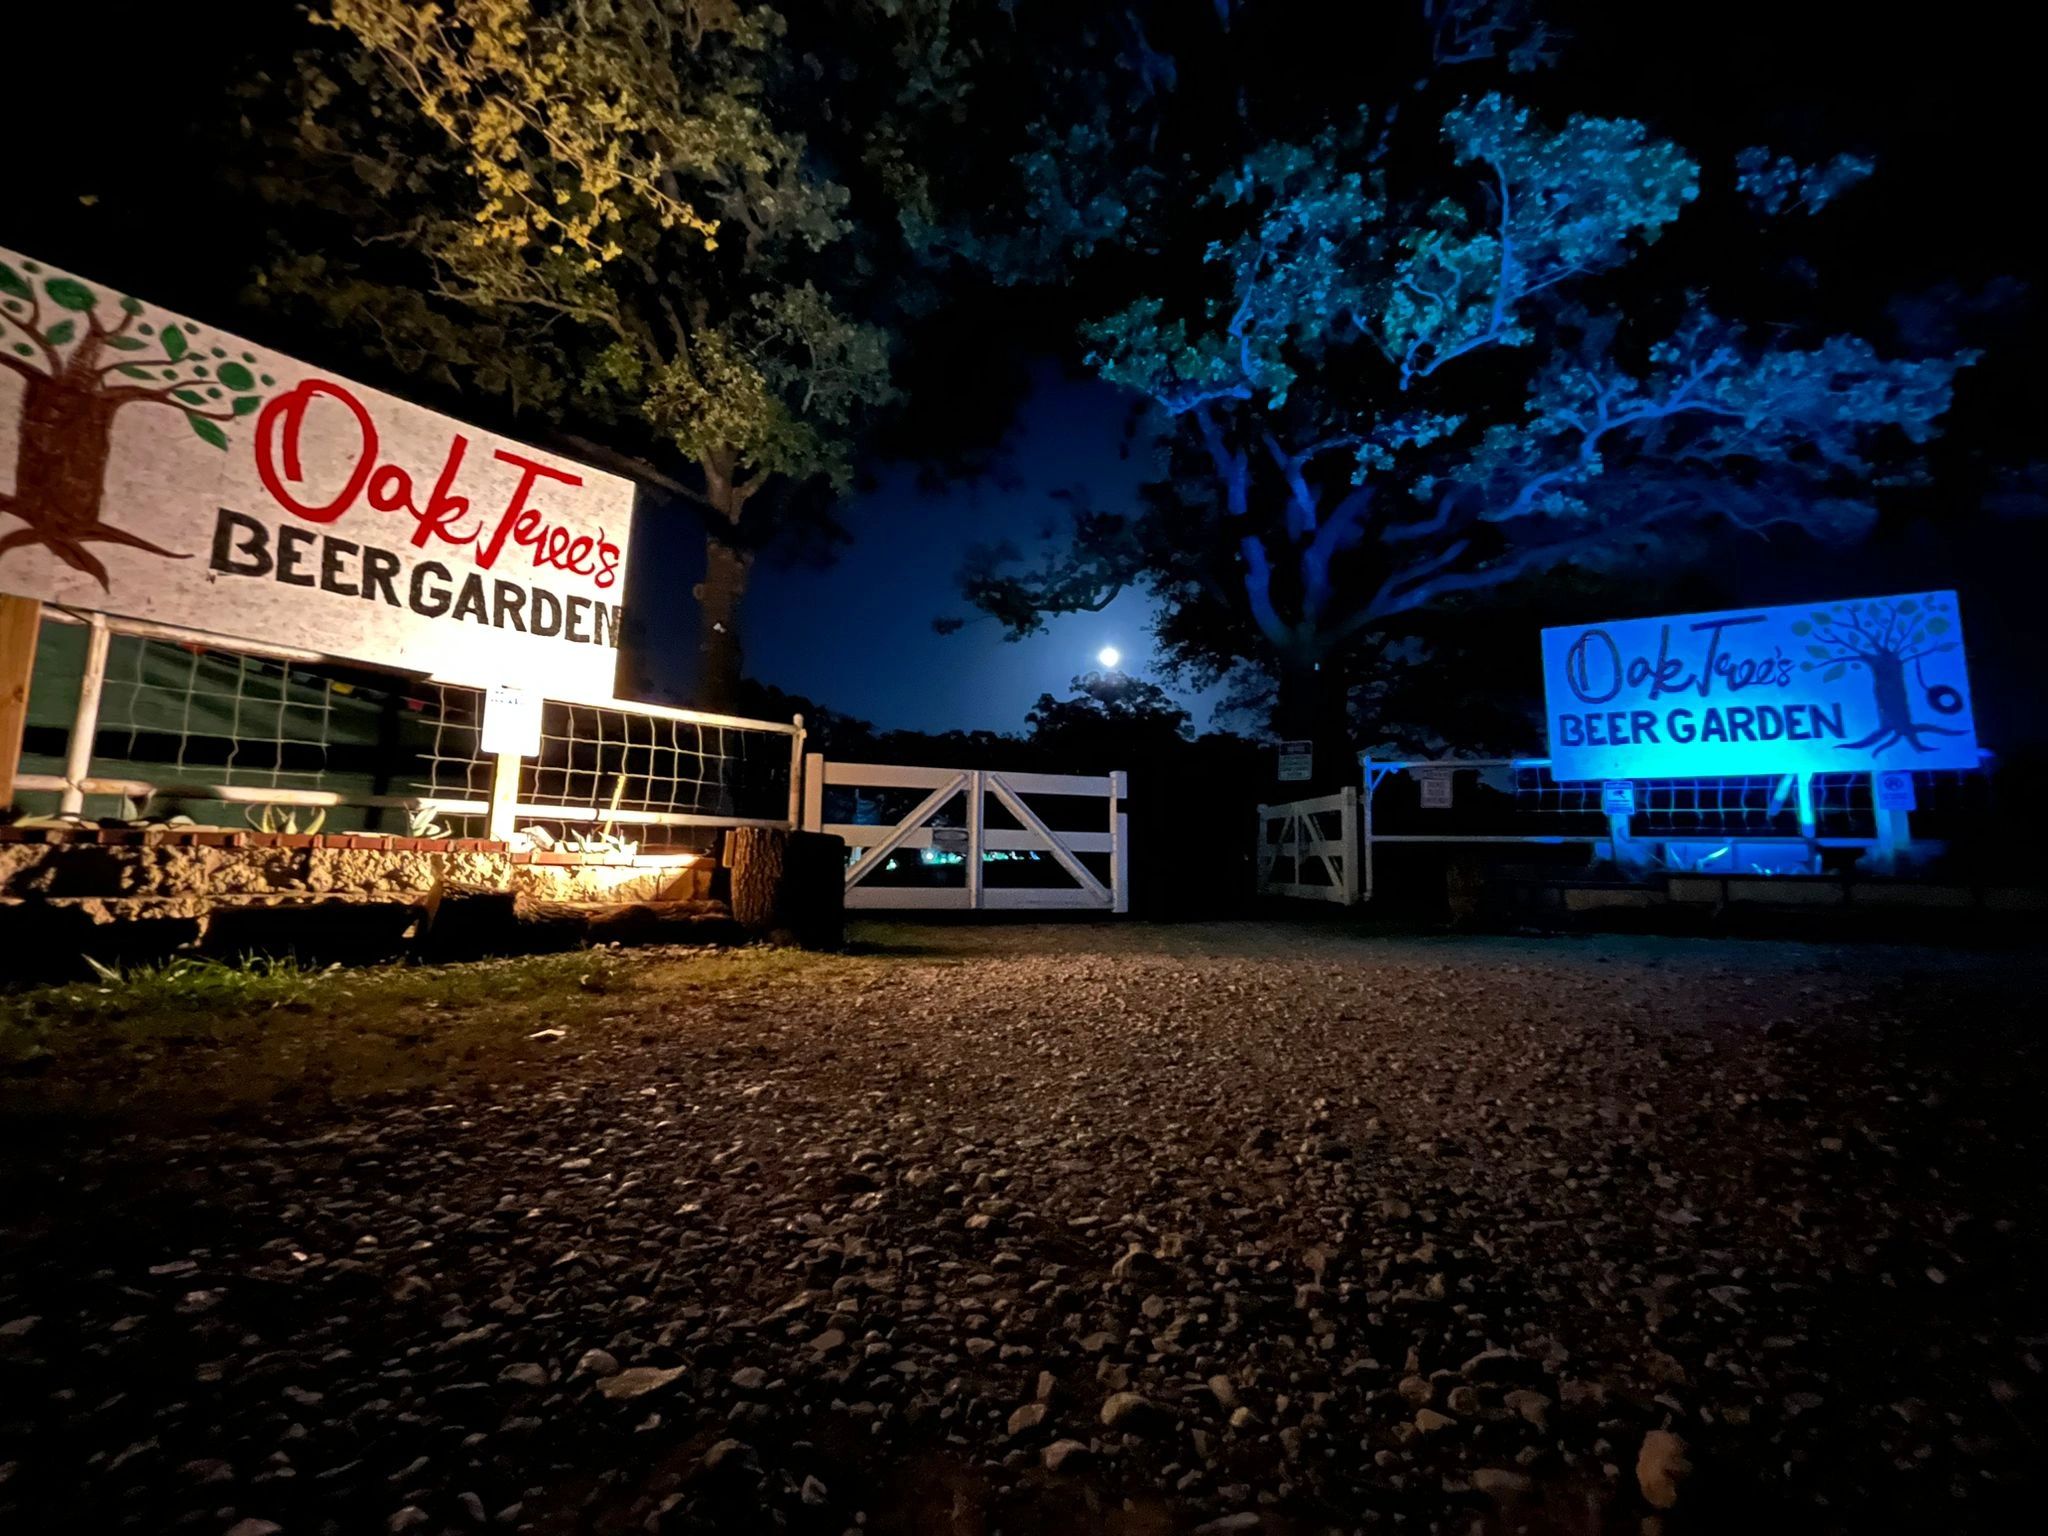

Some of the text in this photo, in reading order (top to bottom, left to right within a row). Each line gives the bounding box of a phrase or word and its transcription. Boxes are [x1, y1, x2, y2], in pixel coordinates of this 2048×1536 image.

[255, 379, 620, 588] Oak Tree's
[1566, 614, 1796, 704] Oak Tree's
[1559, 703, 1848, 746] BEER GARDEN
